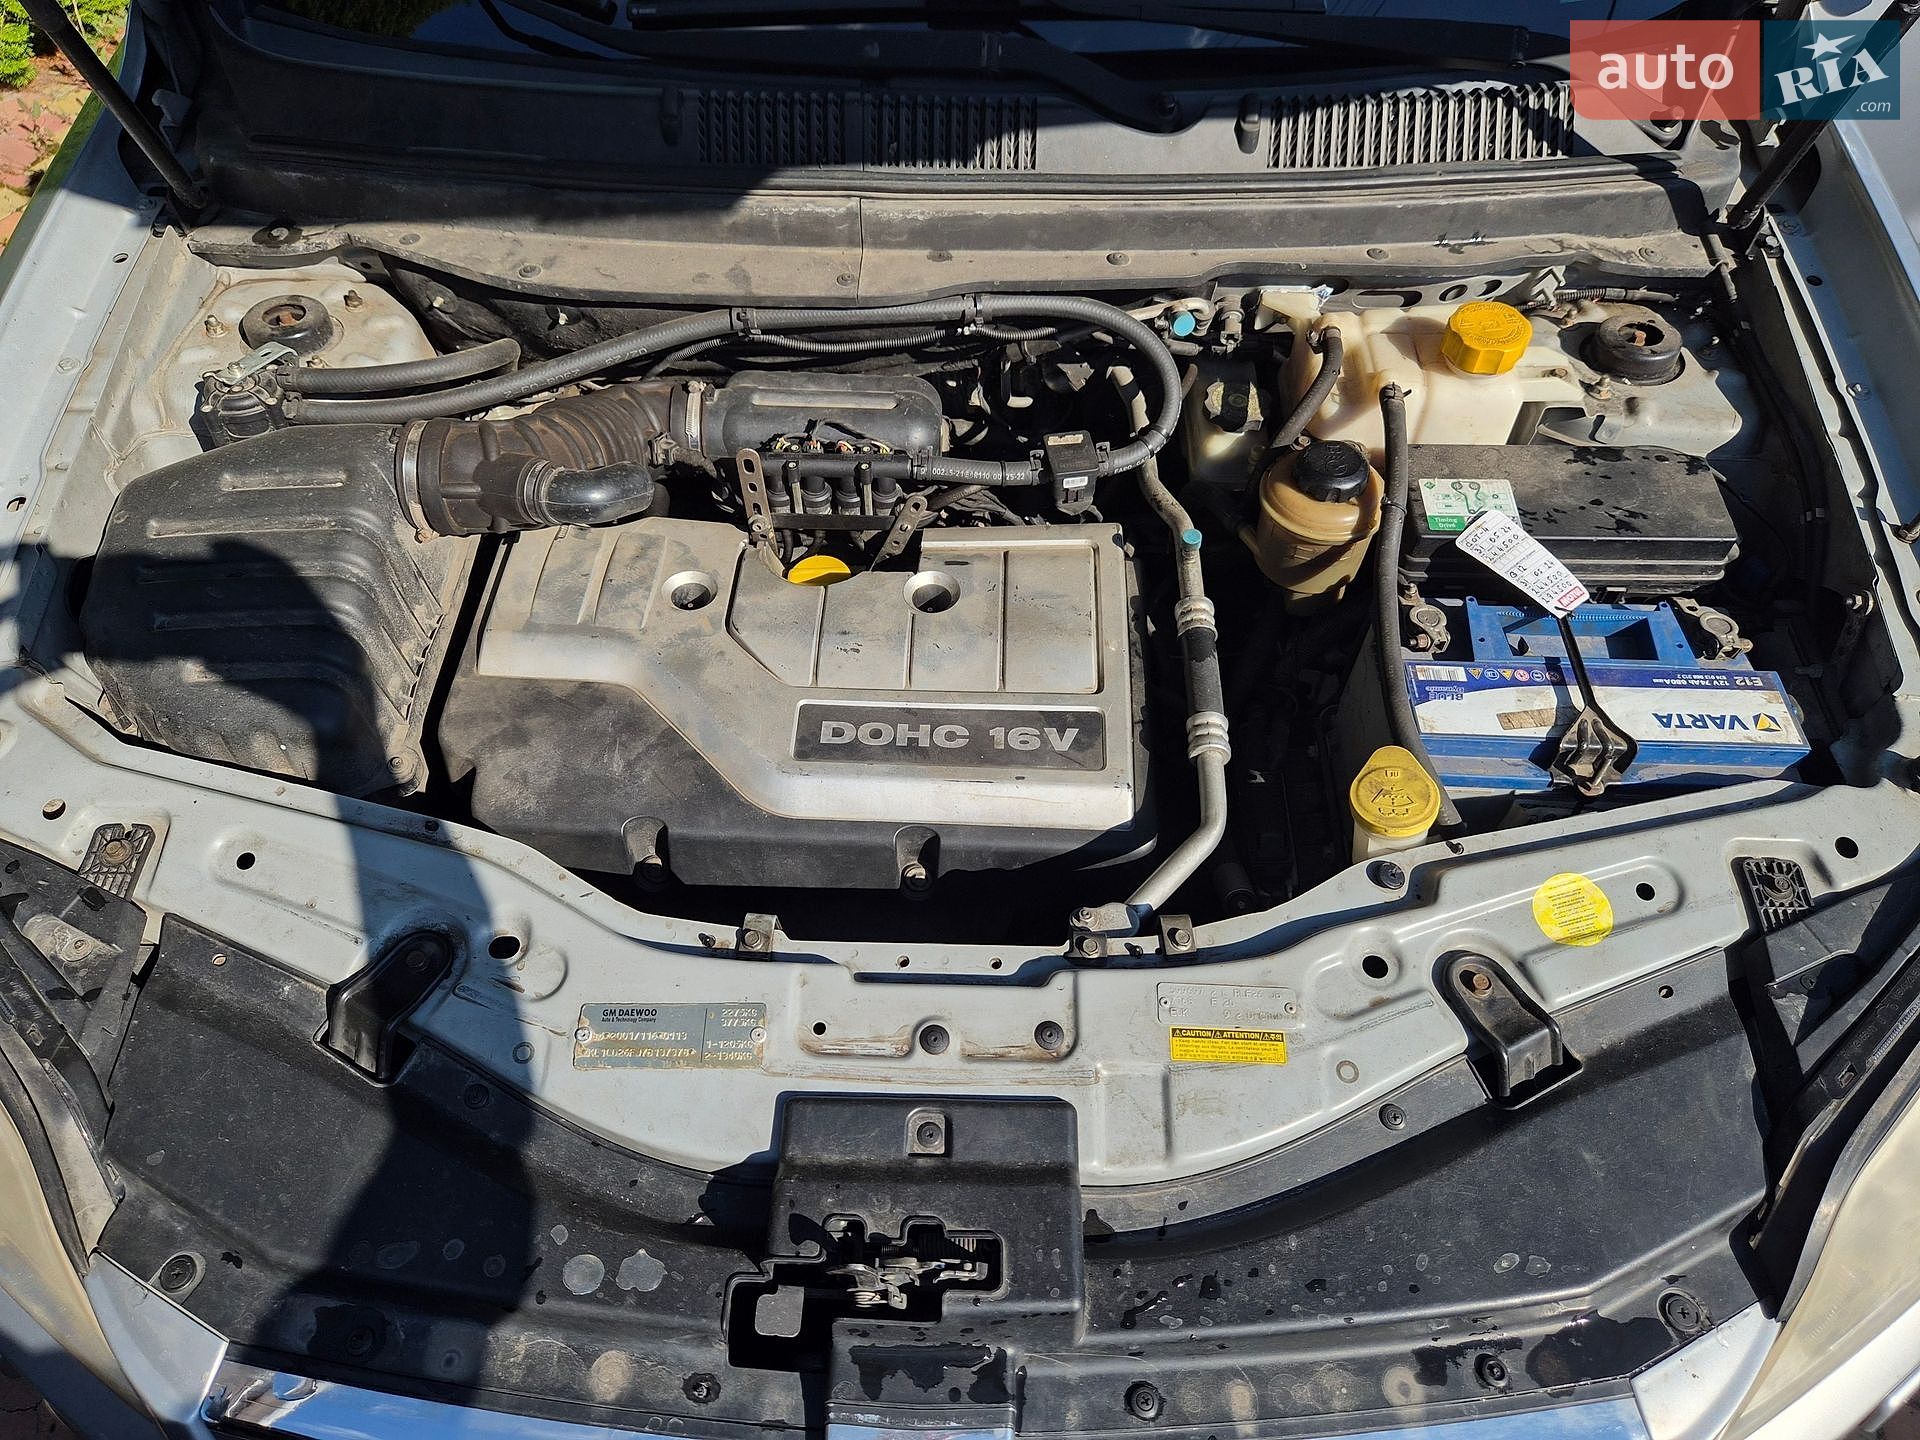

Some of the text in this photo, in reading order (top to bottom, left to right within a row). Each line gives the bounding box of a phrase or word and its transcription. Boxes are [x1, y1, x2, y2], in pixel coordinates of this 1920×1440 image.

[1733, 676, 1763, 686] E12
[1429, 693, 1464, 701] BLUE
[1652, 713, 1750, 731] VARTA
[820, 721, 1079, 752] DOHC 16V
[602, 1008, 658, 1017] GM DAEWOO
[1222, 1031, 1260, 1039] ATTENTION
